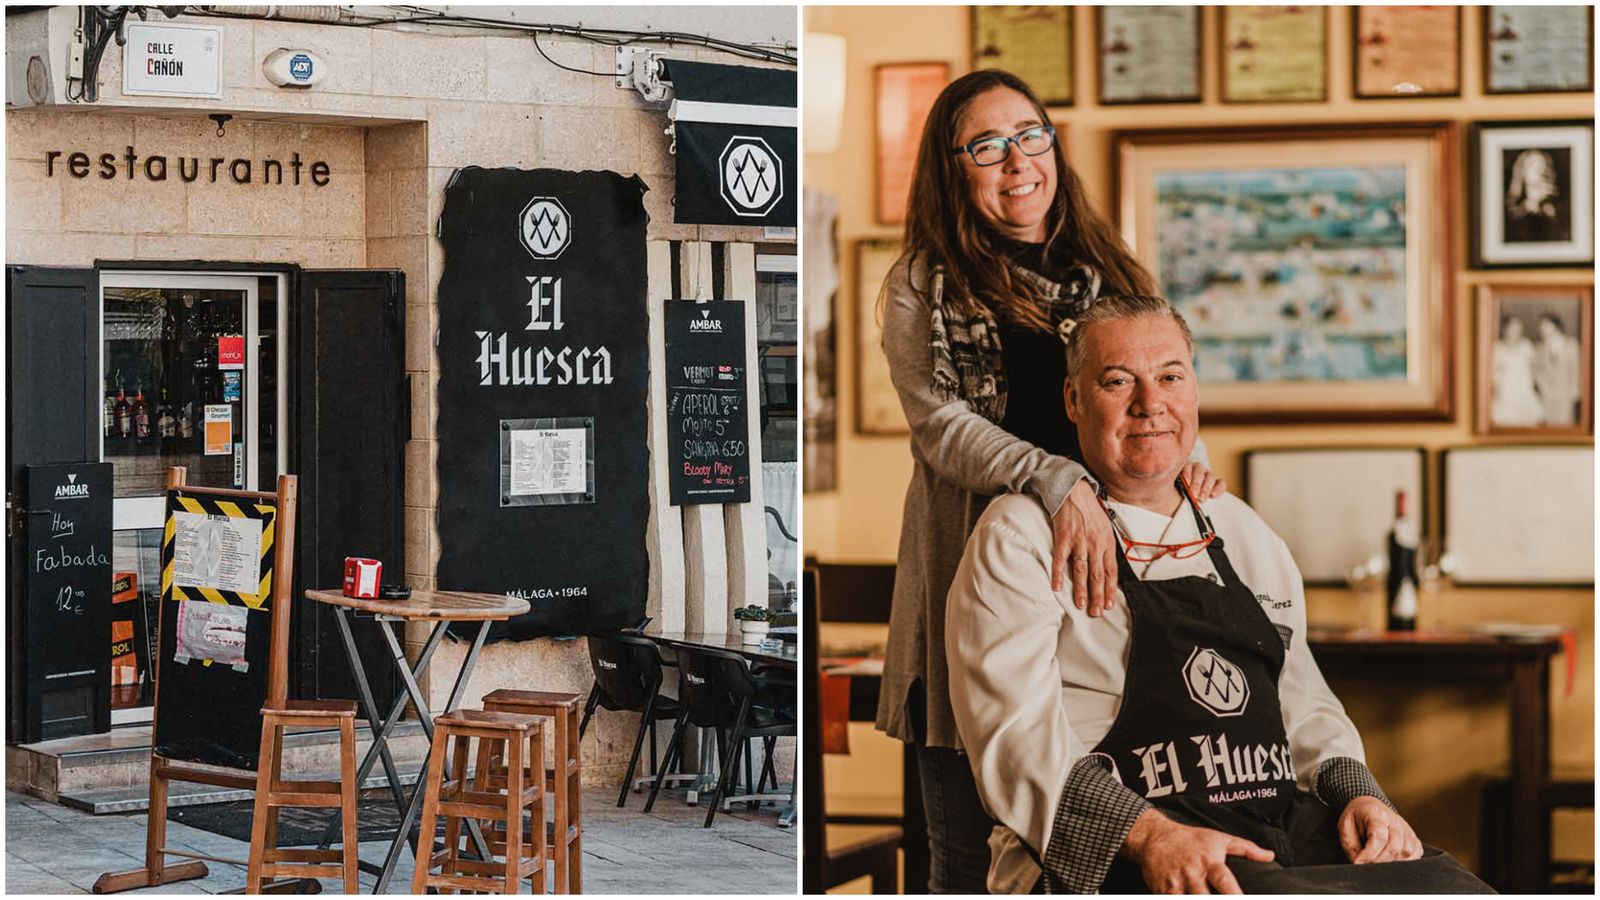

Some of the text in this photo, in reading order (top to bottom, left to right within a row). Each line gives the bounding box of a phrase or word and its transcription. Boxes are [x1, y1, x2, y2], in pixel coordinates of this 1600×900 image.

[147, 43, 174, 55] CALLE
[147, 57, 183, 76] CAÑÓN
[293, 62, 310, 72] ADT
[46, 146, 331, 187] restaurante
[525, 276, 565, 331] El
[690, 319, 722, 330] AMBAR
[475, 331, 614, 386] Huesca
[682, 393, 719, 415] APEROL
[55, 484, 89, 497] AMBAR
[51, 512, 74, 535] Hoy
[36, 544, 112, 573] Fabada
[112, 581, 129, 593] EROL
[1272, 599, 1293, 609] erez
[112, 642, 130, 656] ROL
[1131, 741, 1188, 798] El
[1209, 787, 1277, 803] MÁLAGA 1964
